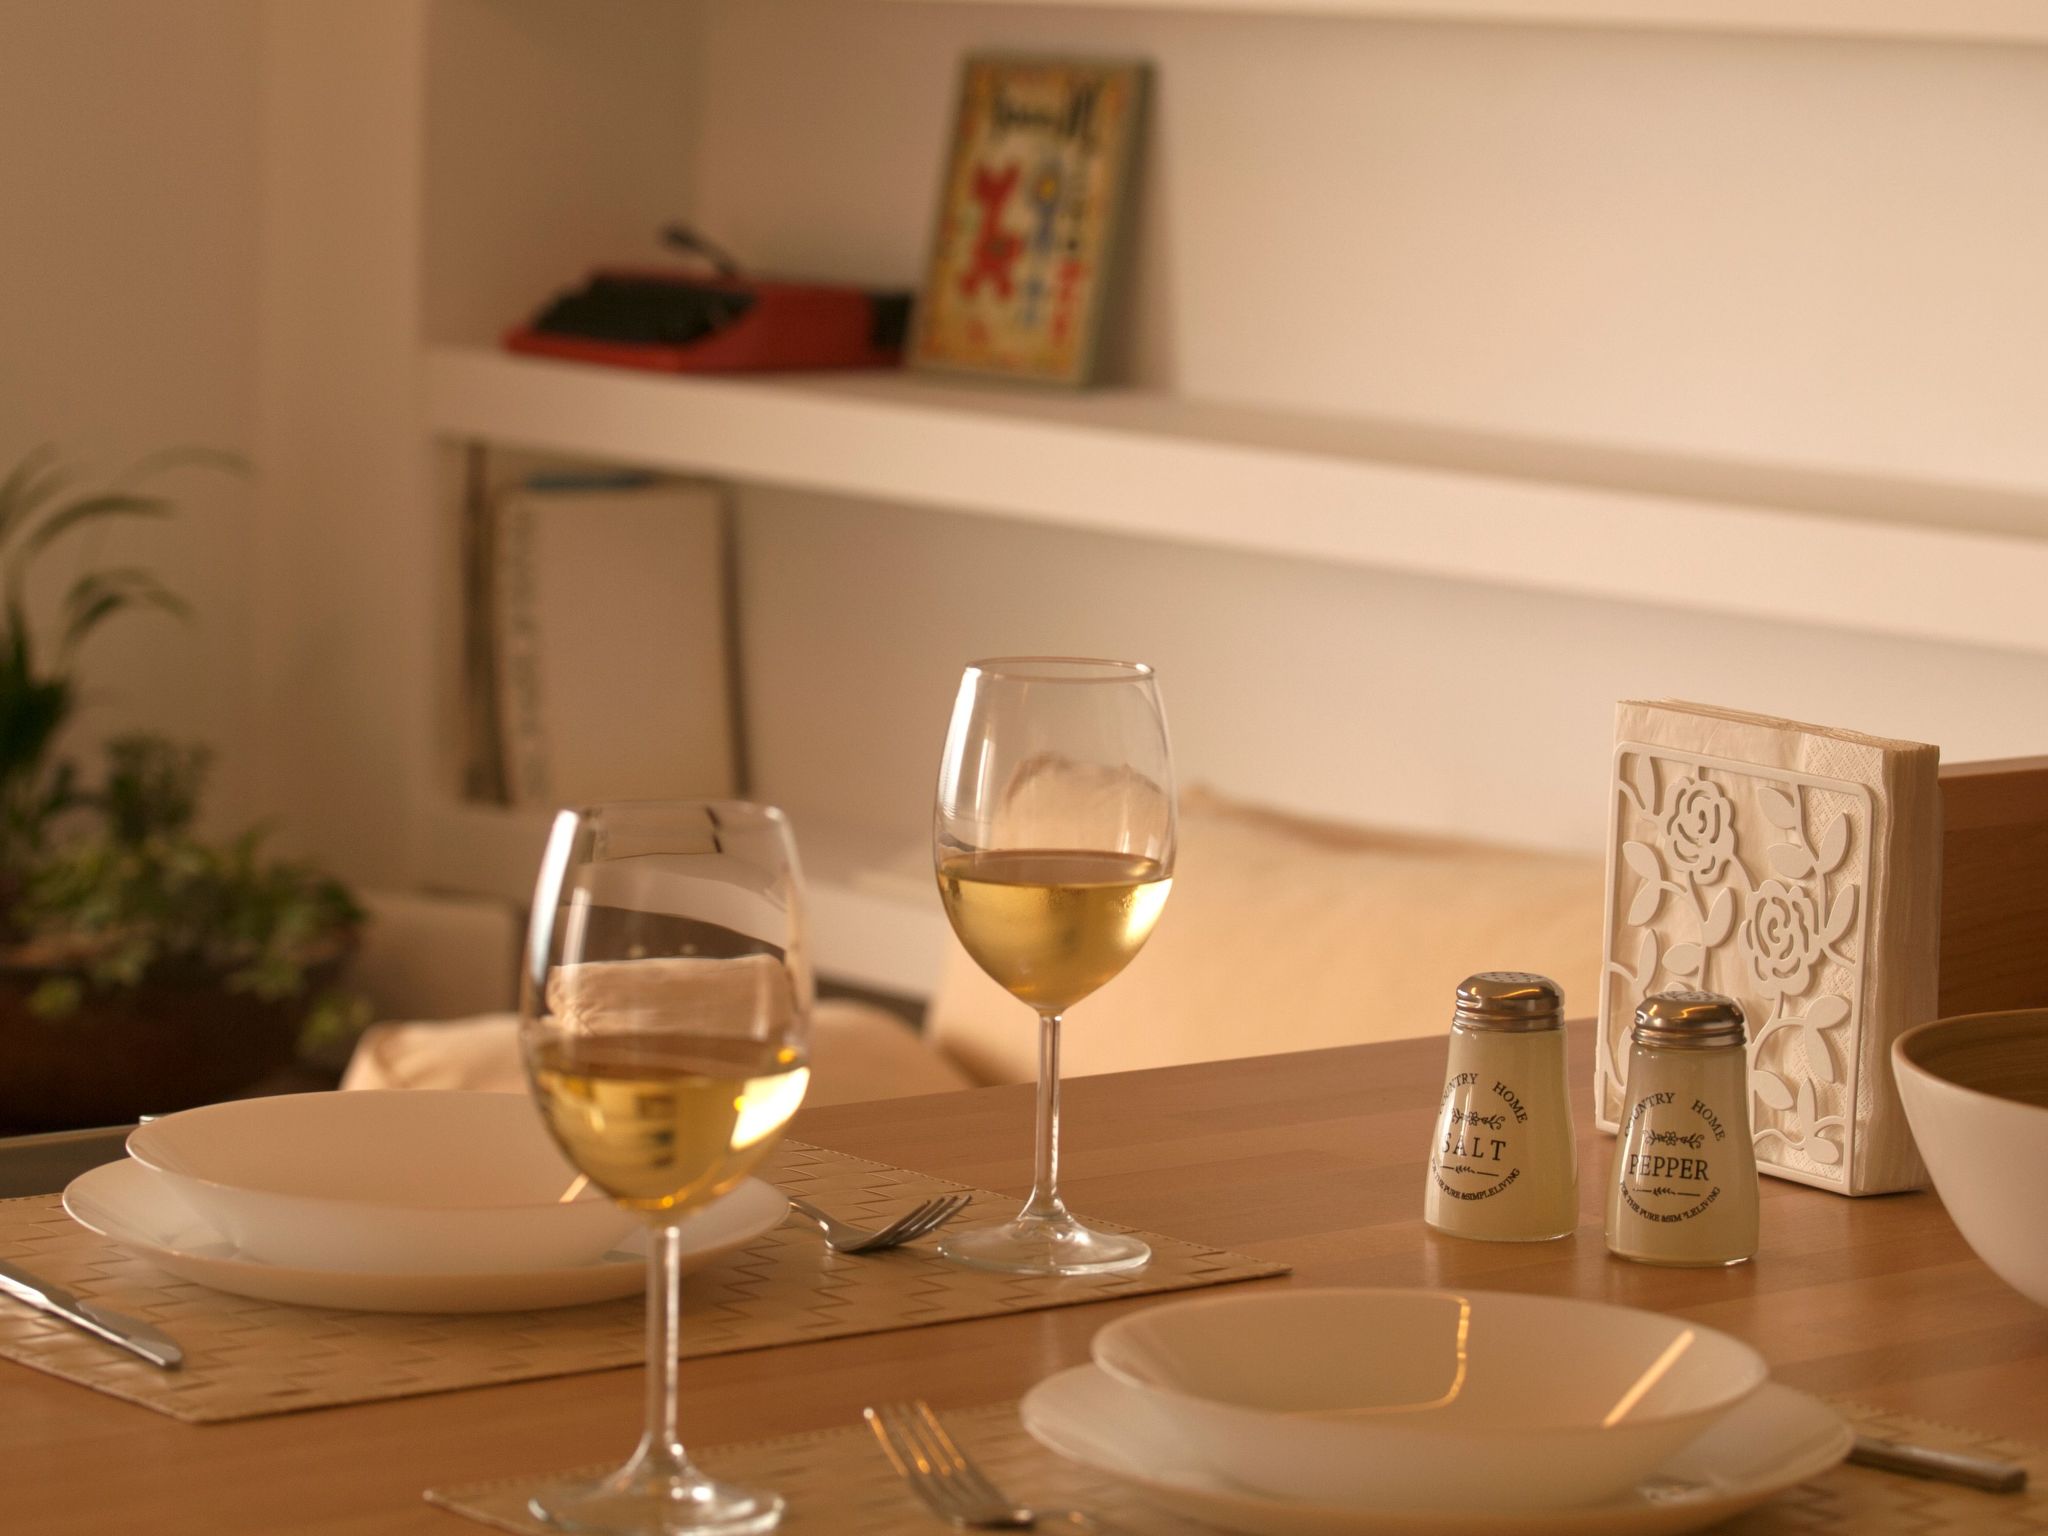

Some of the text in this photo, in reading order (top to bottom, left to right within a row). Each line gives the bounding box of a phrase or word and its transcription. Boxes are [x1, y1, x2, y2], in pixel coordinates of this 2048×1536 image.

[1440, 1073, 1528, 1124] UNTRY HOME
[1691, 1099, 1726, 1141] HOME
[1443, 1132, 1506, 1161] SALT
[1629, 1154, 1710, 1181] PEPPER
[1443, 1185, 1461, 1199] PURE
[1627, 1195, 1640, 1213] THE
[1639, 1208, 1660, 1222] PURE
